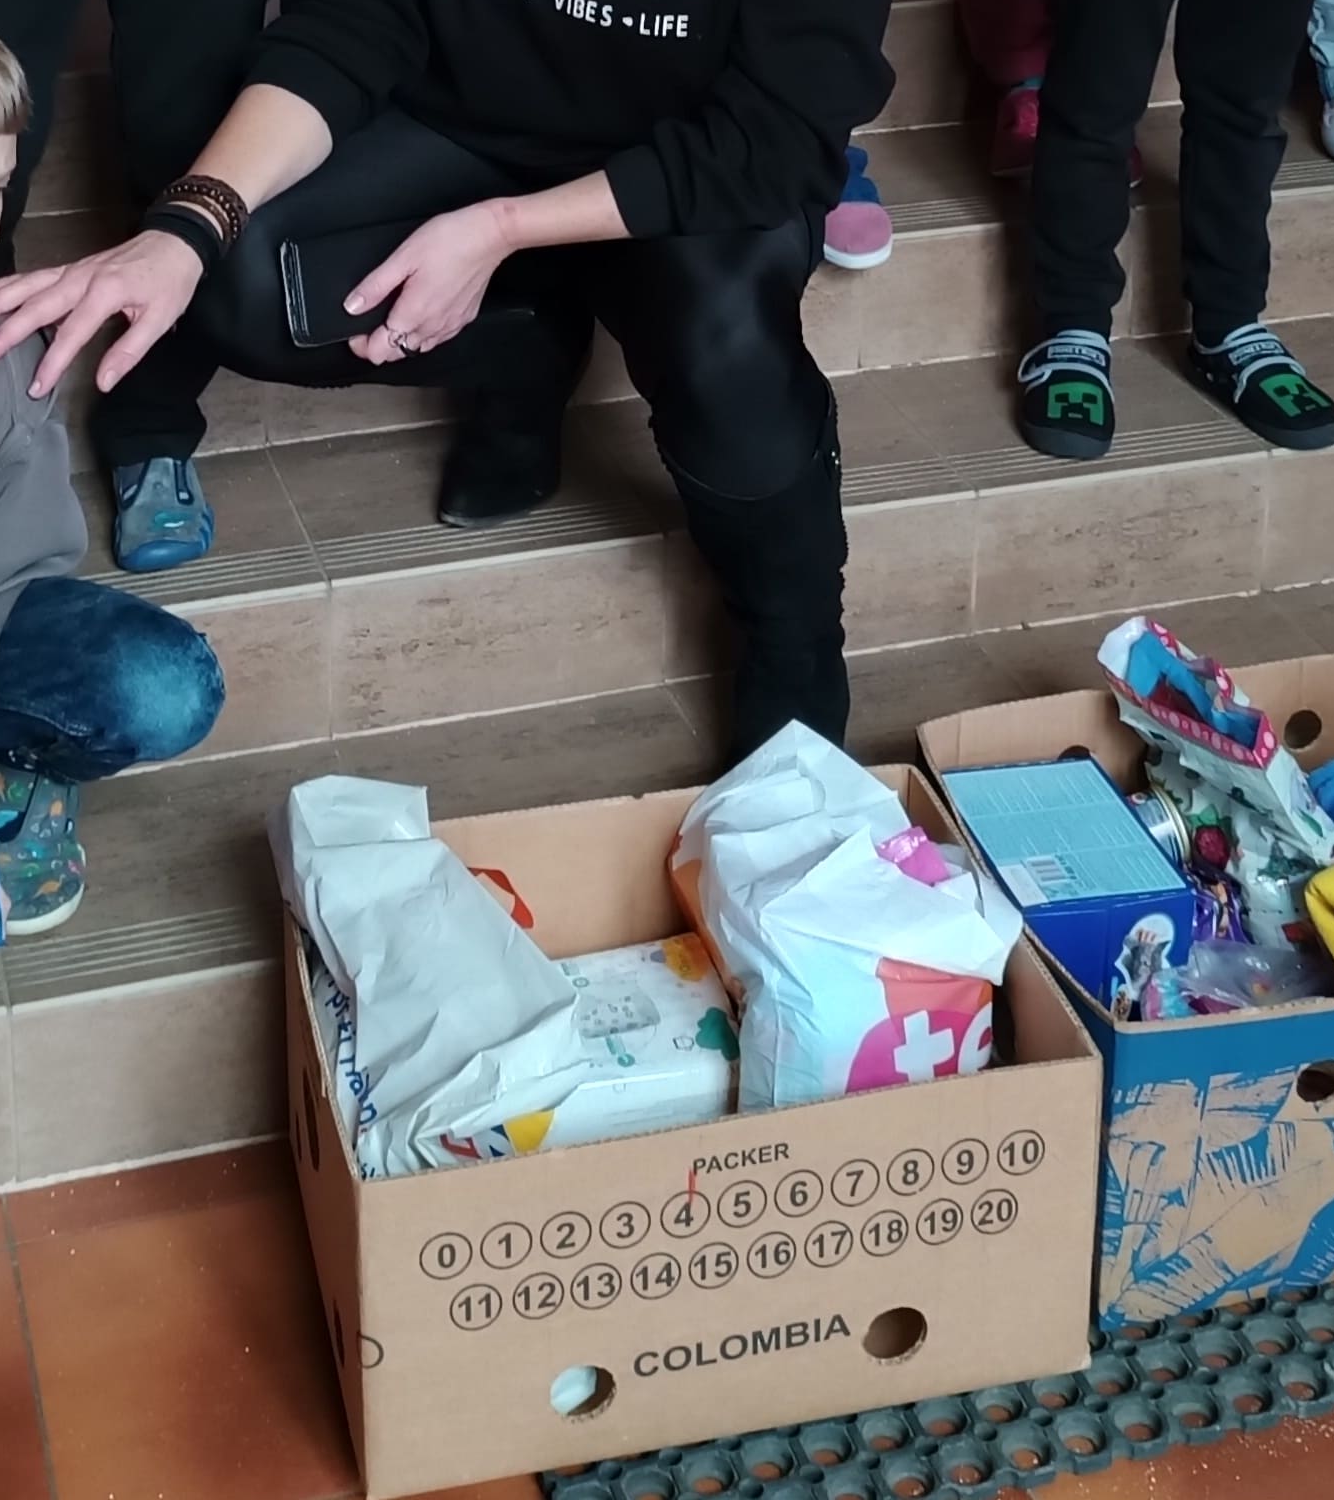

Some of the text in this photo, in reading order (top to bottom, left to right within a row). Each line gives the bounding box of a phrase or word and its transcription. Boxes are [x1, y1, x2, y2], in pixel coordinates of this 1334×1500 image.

[639, 12, 689, 38] LIFE
[691, 1141, 791, 1176] PACKER
[438, 1137, 1039, 1268] 0 1 2 3 4 5 6 7 8 9 10
[459, 1199, 1012, 1321] 11 12 13 14 15 16 17 18 19 20
[633, 1312, 852, 1378] COLOMBIA
